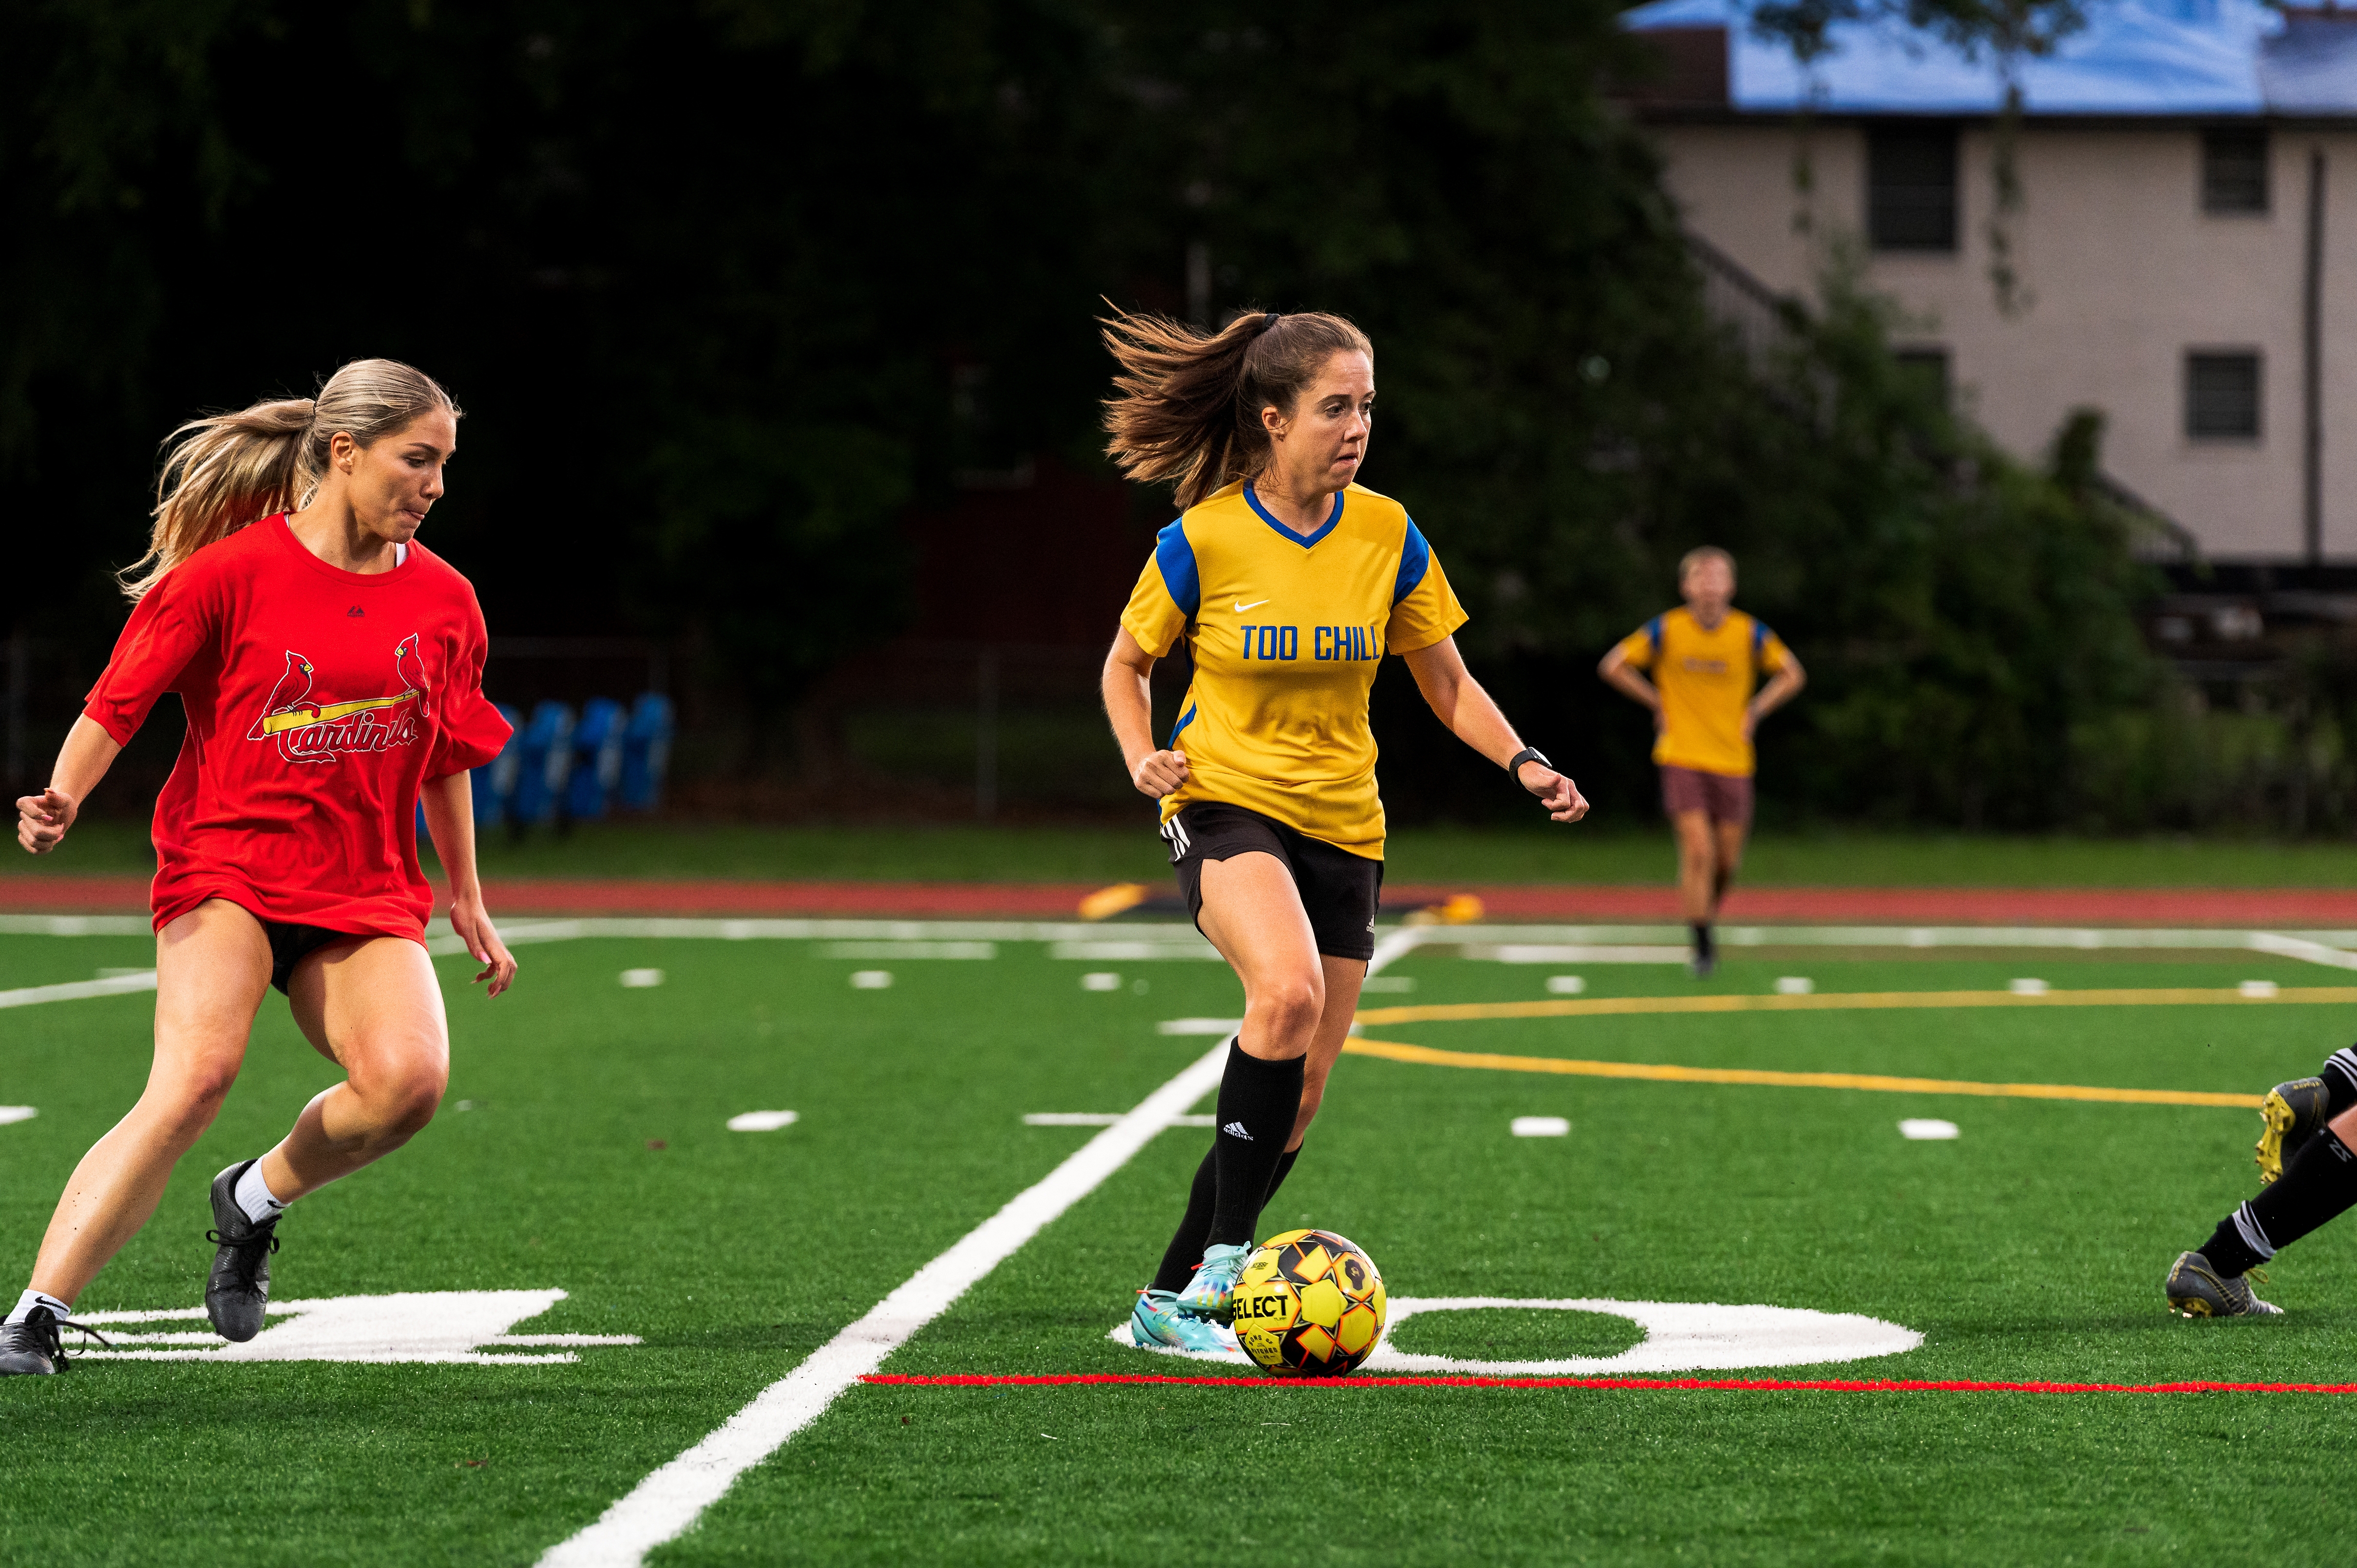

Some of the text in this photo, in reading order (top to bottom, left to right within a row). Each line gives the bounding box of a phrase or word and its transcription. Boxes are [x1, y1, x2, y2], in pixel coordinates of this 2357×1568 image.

[1241, 625, 1380, 661] TOO CHILL
[1223, 1127, 1254, 1141] adidas
[1232, 1295, 1288, 1321] SELECT
[1249, 1335, 1262, 1346] SONS
